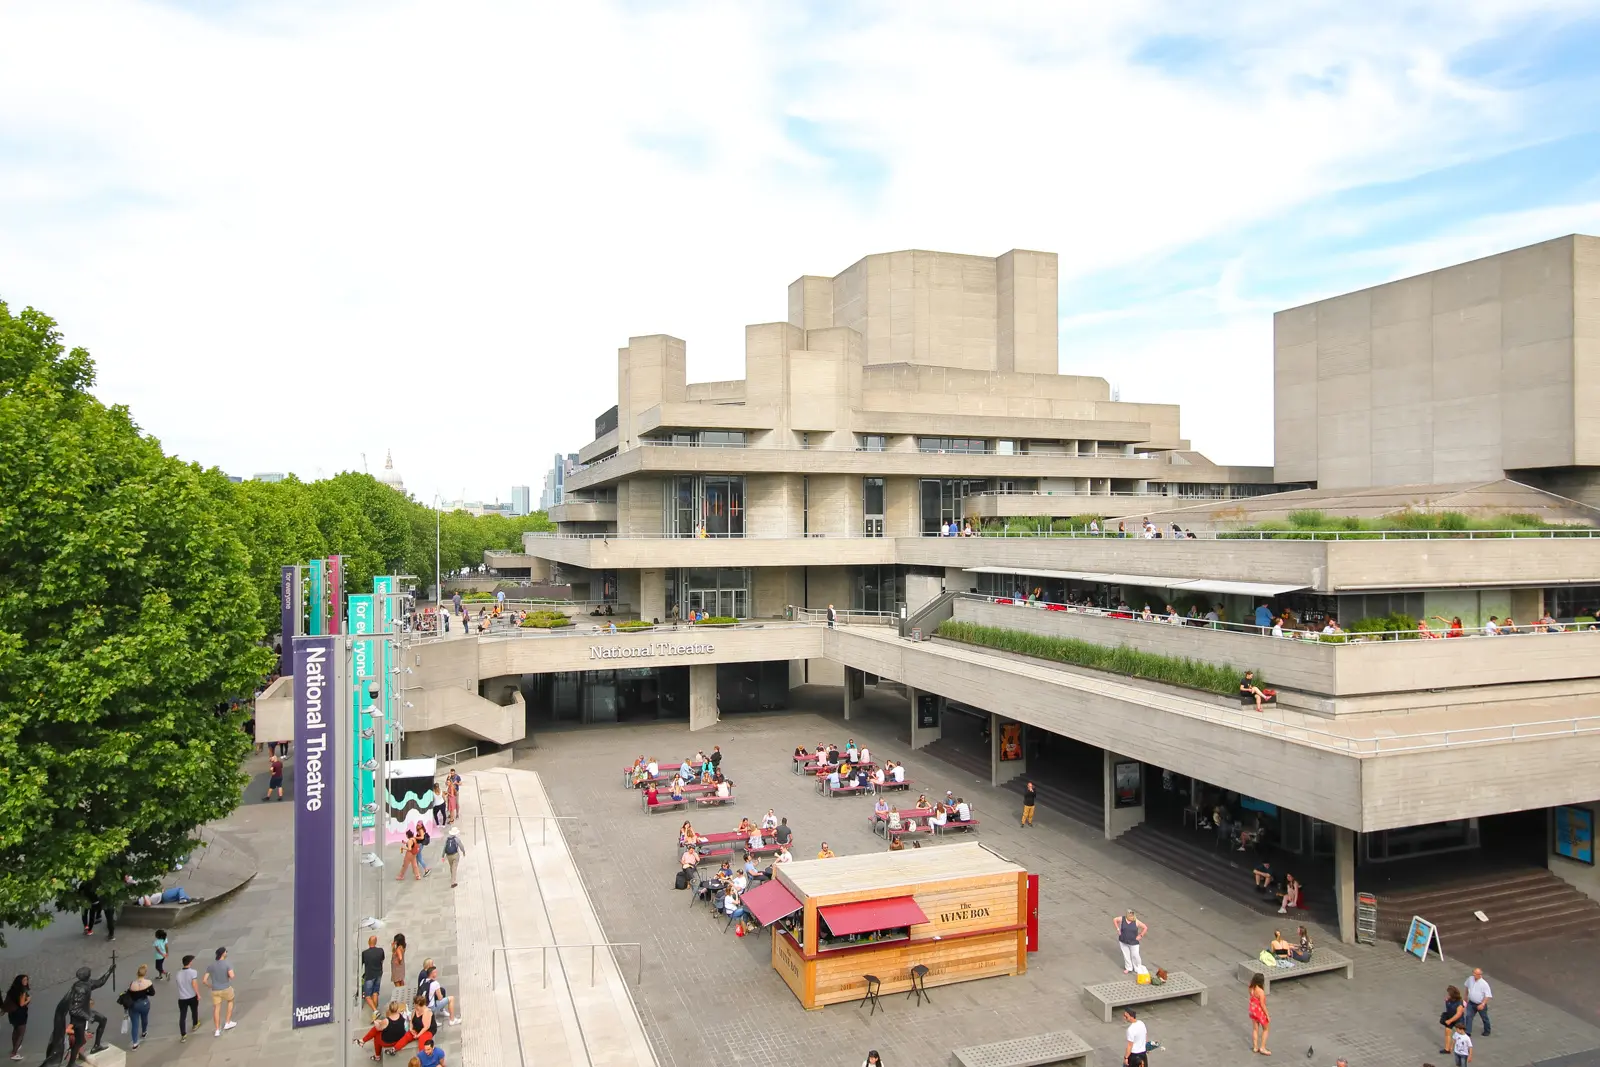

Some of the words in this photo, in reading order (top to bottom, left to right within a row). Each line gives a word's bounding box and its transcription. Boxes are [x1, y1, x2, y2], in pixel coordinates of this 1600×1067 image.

[356, 601, 368, 619] for
[354, 621, 367, 676] evryone
[590, 643, 655, 660] National
[656, 642, 716, 657] Theatre
[306, 647, 326, 729] National
[306, 733, 326, 811] Theatre
[940, 910, 969, 923] WINE
[970, 907, 990, 919] BOX
[295, 1003, 331, 1017] National
[297, 1011, 330, 1022] Theatre
